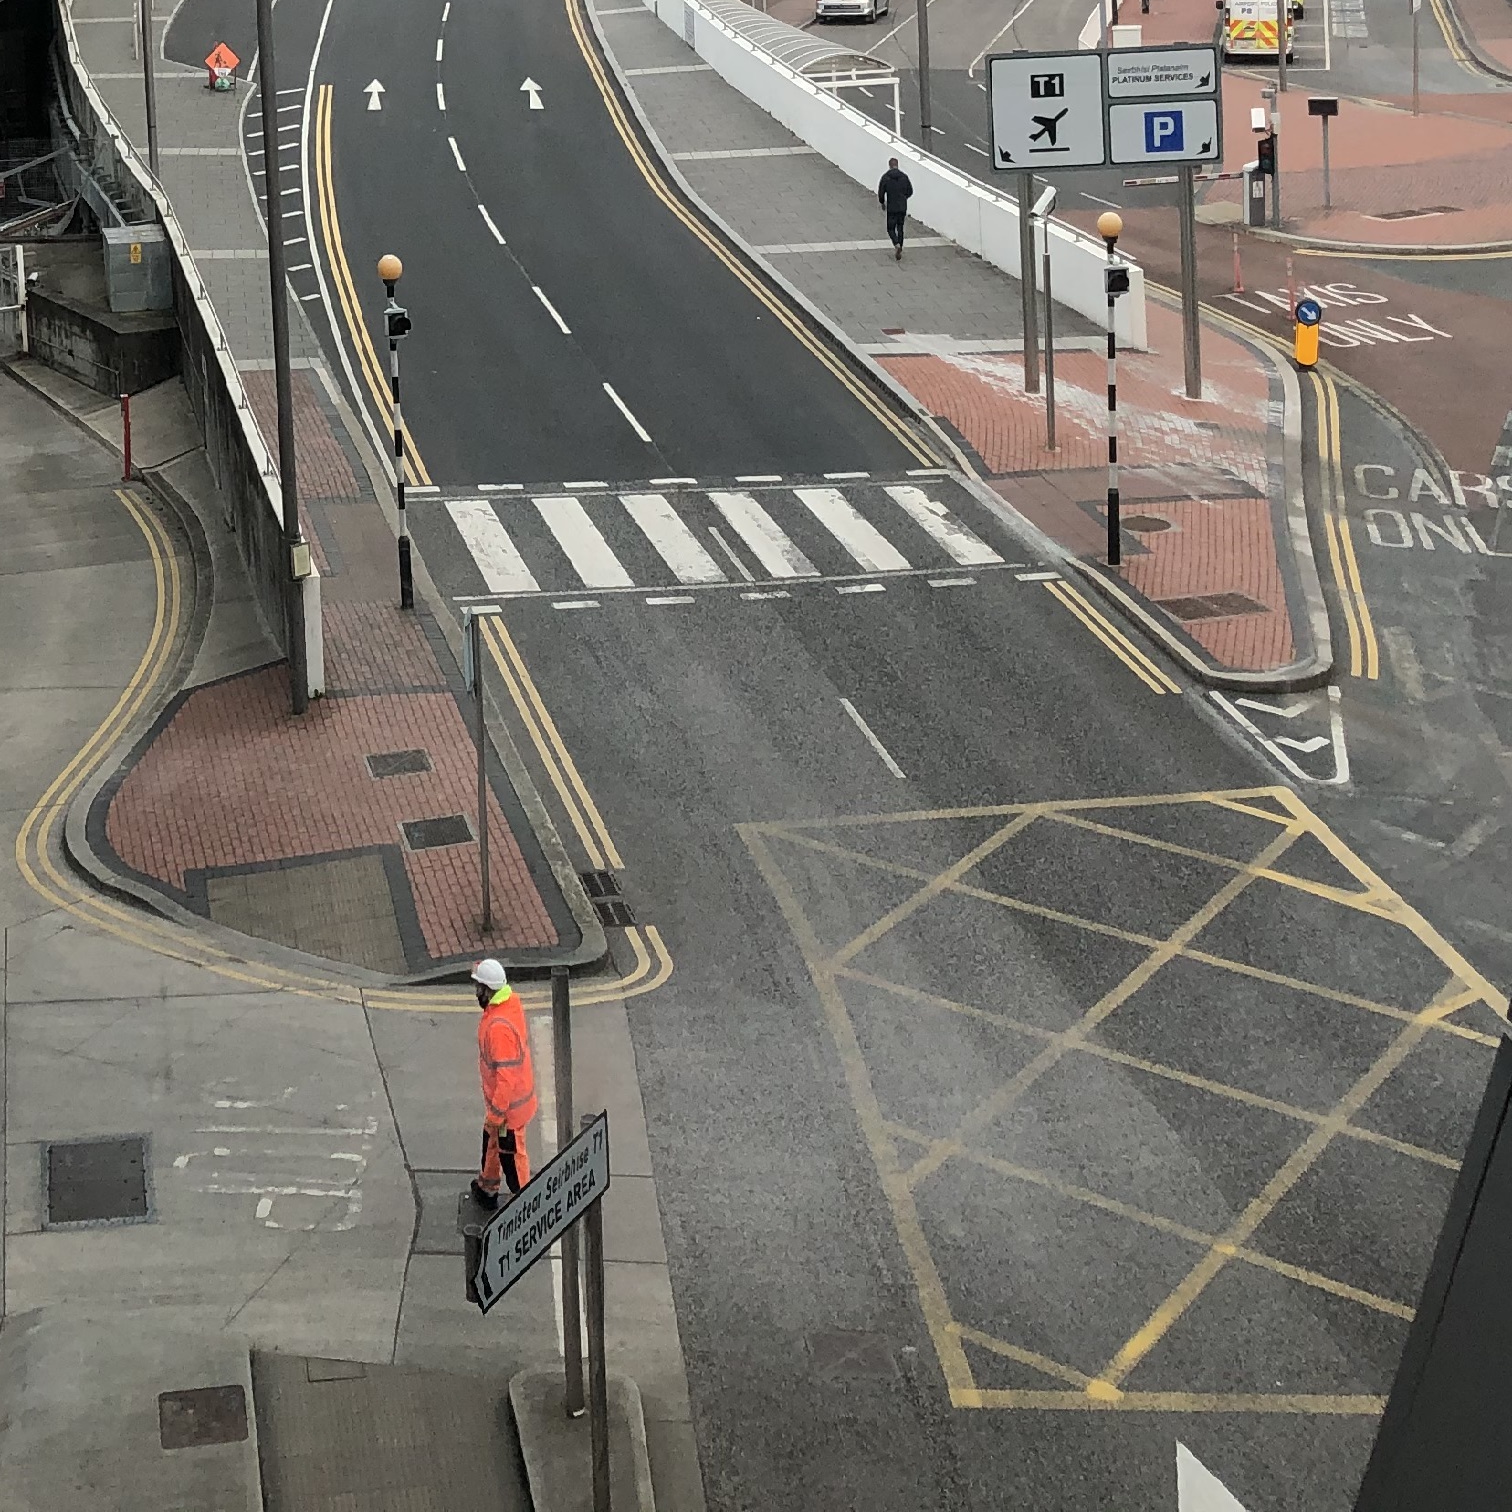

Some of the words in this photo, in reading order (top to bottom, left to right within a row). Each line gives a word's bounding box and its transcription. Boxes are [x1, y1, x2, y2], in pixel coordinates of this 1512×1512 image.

[1034, 76, 1061, 96] T1
[1111, 75, 1152, 84] PLATINUM
[1154, 72, 1194, 82] SERVICES
[1154, 116, 1175, 148] P
[1212, 282, 1389, 315] TAXIS
[1363, 508, 1512, 557] ONL
[592, 1128, 603, 1155] T1
[498, 1250, 510, 1278] T1
[515, 1200, 563, 1263] SERVICE
[566, 1168, 596, 1213] AREA
